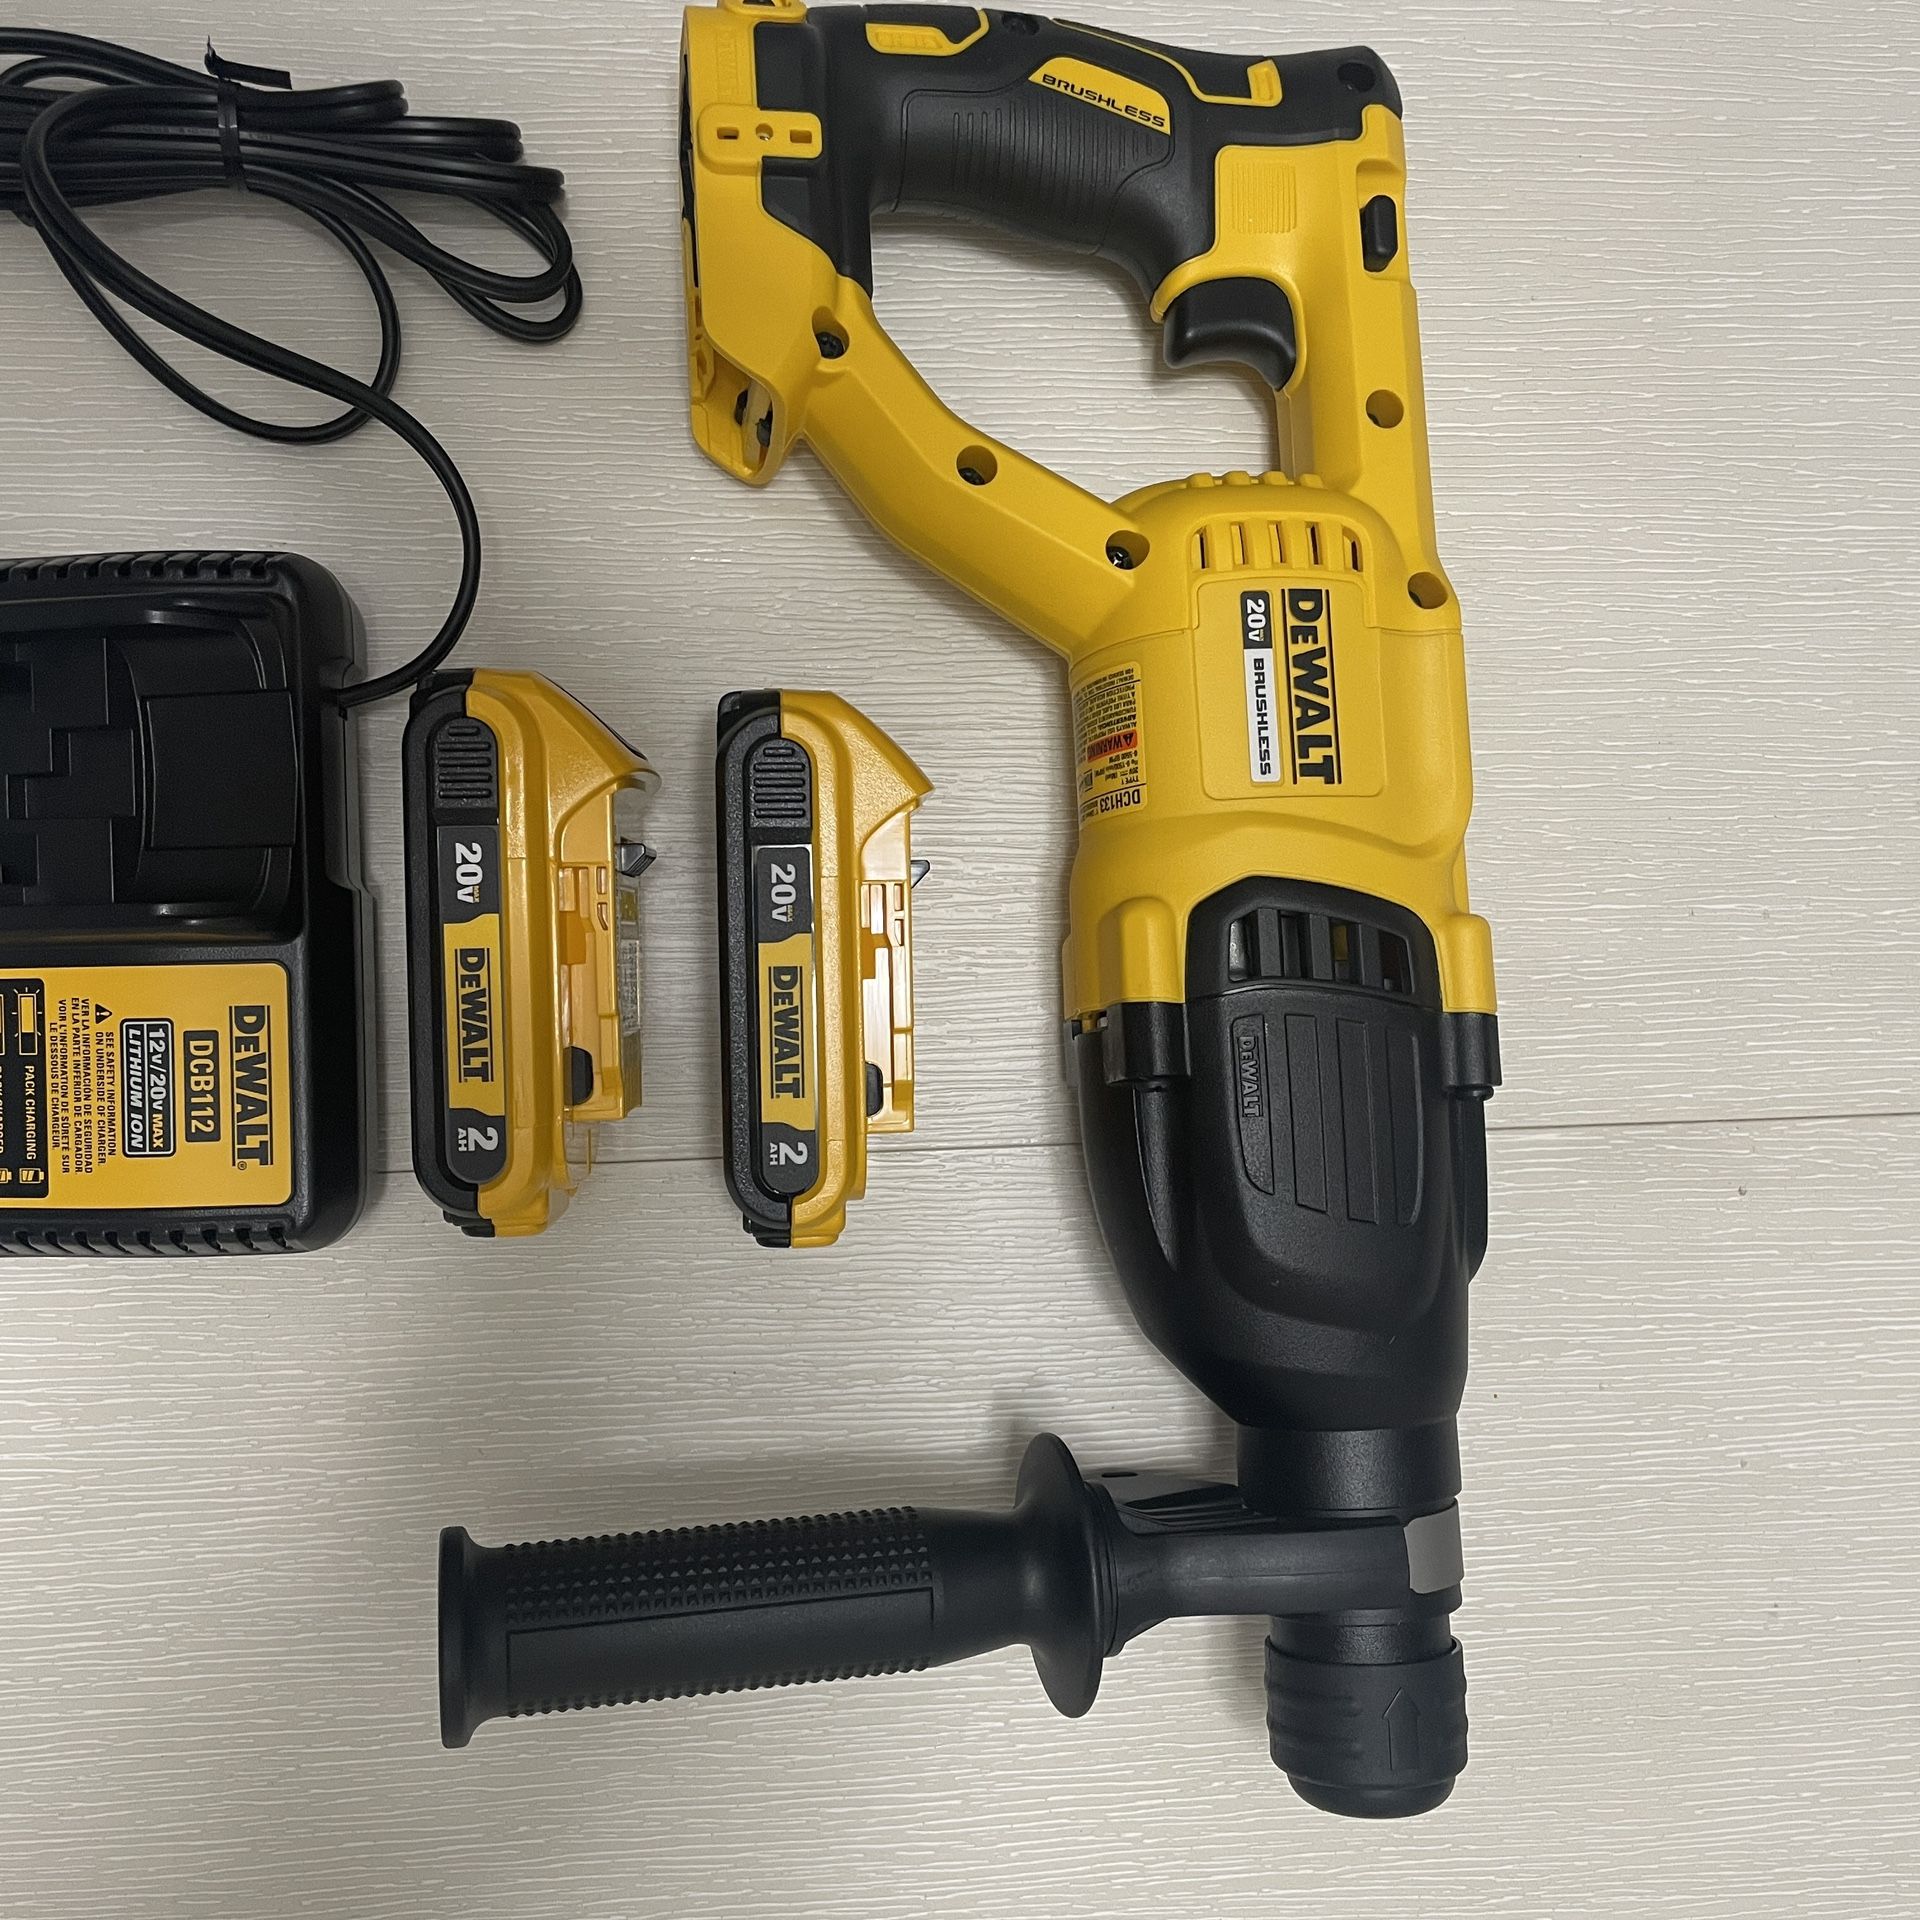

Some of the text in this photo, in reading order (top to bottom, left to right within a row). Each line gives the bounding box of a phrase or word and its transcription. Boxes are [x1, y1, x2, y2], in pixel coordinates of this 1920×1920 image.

[1042, 73, 1165, 127] BRUSHLESS
[1289, 588, 1335, 785] DEWALT
[1253, 658, 1271, 776] BRUSHLESS
[1099, 789, 1141, 814] DCH133
[50, 1022, 57, 1032] LE
[82, 1020, 90, 1031] LA
[460, 947, 489, 1082] DEWALT
[773, 966, 800, 1098] DEWALT
[50, 1036, 58, 1079] DESSOUS
[59, 1024, 68, 1098] L'INFORMATION
[82, 1034, 93, 1101] INFORMACIÓN
[1240, 1036, 1259, 1116] DEWALT
[25, 1065, 36, 1160] PACK CHARGING
[51, 1082, 59, 1094] DE
[61, 1101, 69, 1113] DE
[72, 998, 82, 1175] EN LA PARTE INFERIOR DE CARGADOR.
[84, 1104, 92, 1116] DE
[96, 1031, 106, 1166] ON UNDERSIDE OF CHARGER.
[106, 1031, 116, 1156] SEE SAFETY INFORMATION
[129, 1028, 143, 1148] LITHIUM ION
[189, 1040, 214, 1133] DCB112
[234, 1005, 269, 1166] DEWALT
[61, 1116, 71, 1151] SÛRETÉ
[84, 1119, 92, 1173] SEGURIDAD
[152, 1113, 163, 1148] MAX
[458, 1127, 467, 1152] AH
[467, 1127, 498, 1151] 2
[769, 1142, 778, 1166] AH
[778, 1142, 808, 1165] 2
